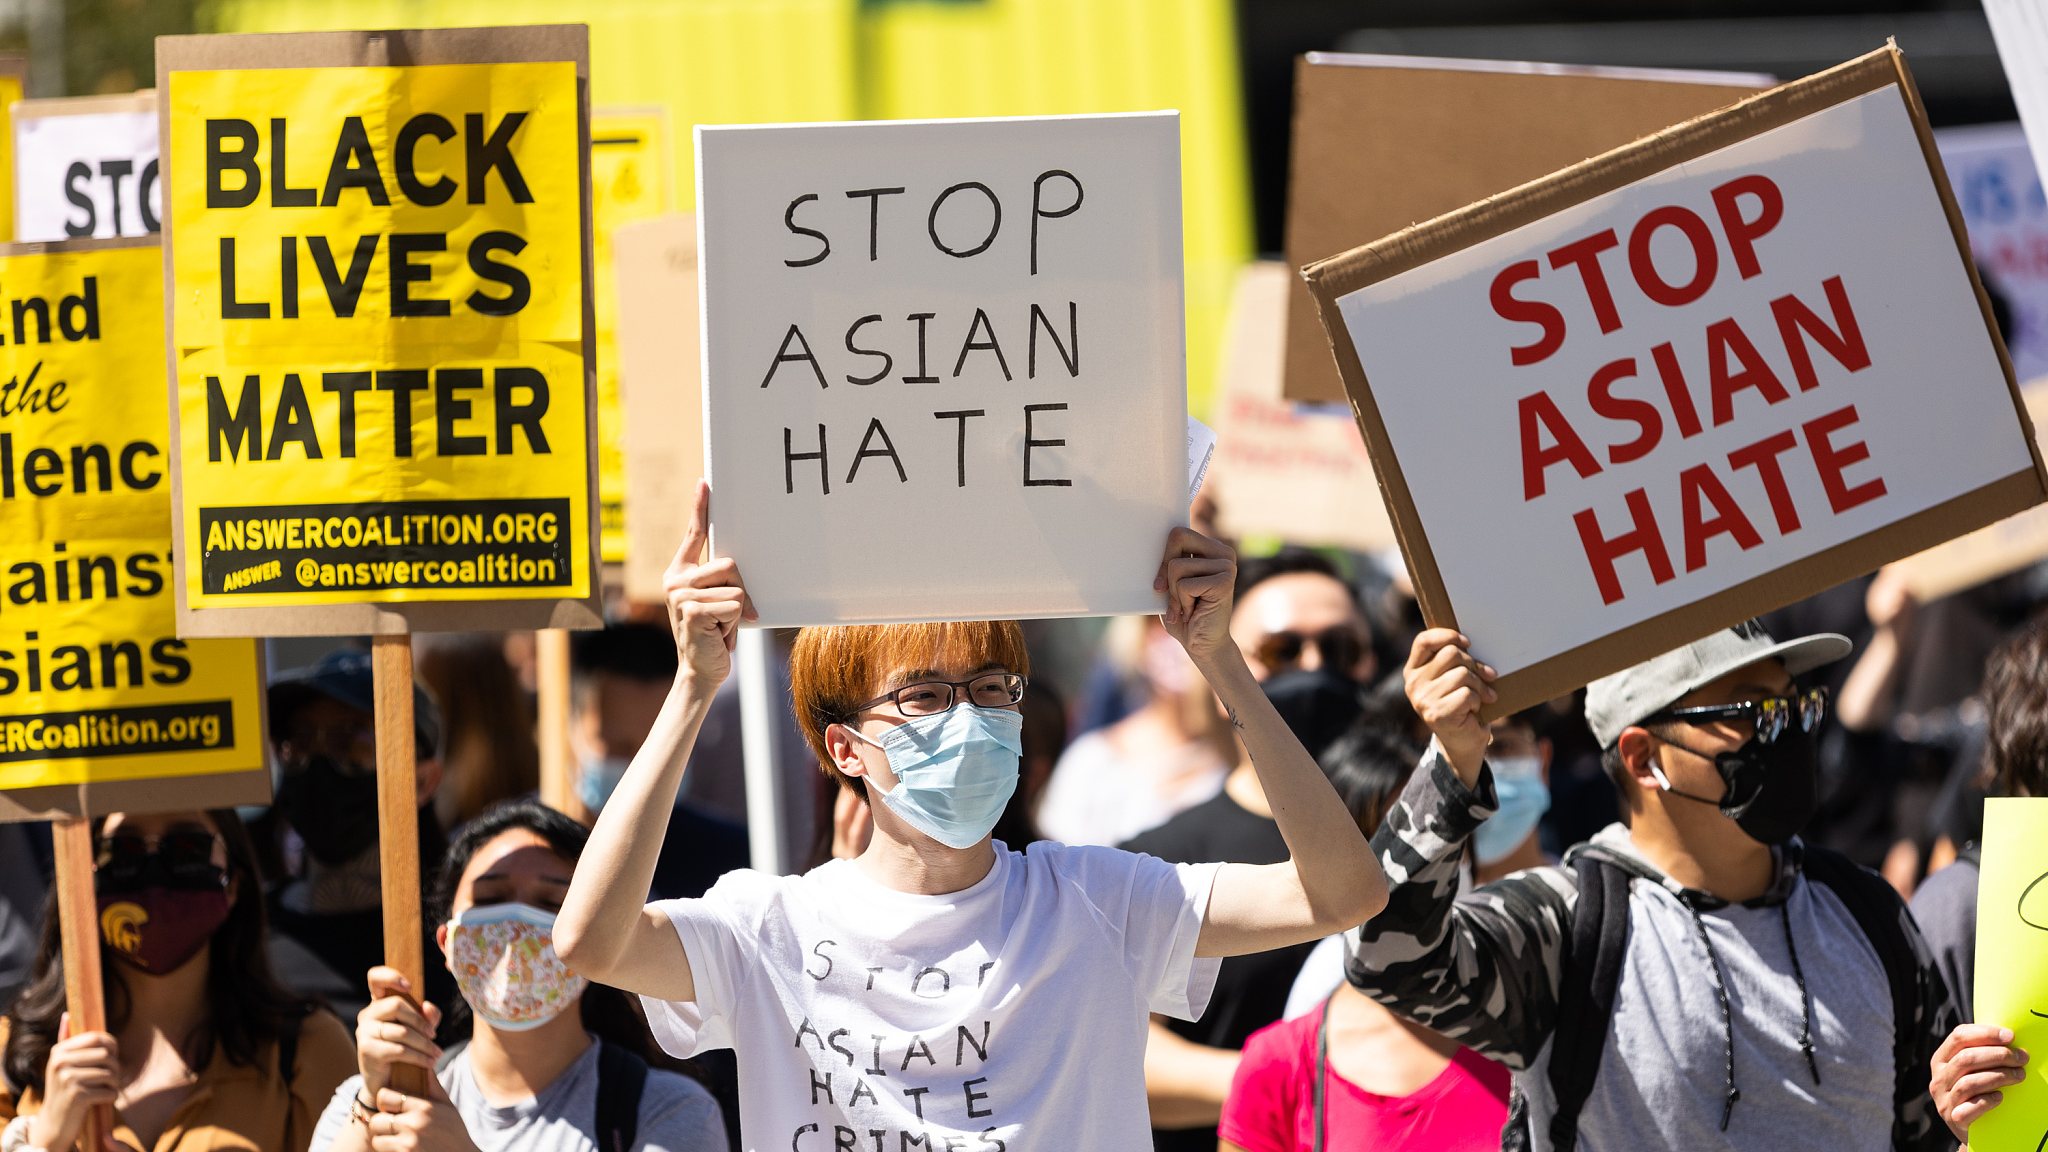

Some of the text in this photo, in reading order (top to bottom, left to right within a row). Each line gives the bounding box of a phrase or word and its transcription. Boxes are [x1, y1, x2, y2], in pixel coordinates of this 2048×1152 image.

[206, 112, 535, 209] BLACK
[783, 169, 1084, 277] STOP
[0, 276, 101, 346] nd
[220, 230, 531, 319] LIVES
[1489, 174, 1784, 366] STOP
[0, 361, 70, 418] the
[761, 301, 1080, 391] ASIAN
[1517, 275, 1872, 501] ASIAN
[206, 367, 552, 464] MATTER
[784, 402, 1073, 495] HATE
[206, 512, 559, 552] ANSWERCOALITION.ORG
[1572, 403, 1889, 607] HATE
[222, 560, 282, 593] ANSWER
[295, 553, 556, 588] @answercoalition
[794, 1014, 991, 1077] ASIAN
[809, 1067, 993, 1125] HATE
